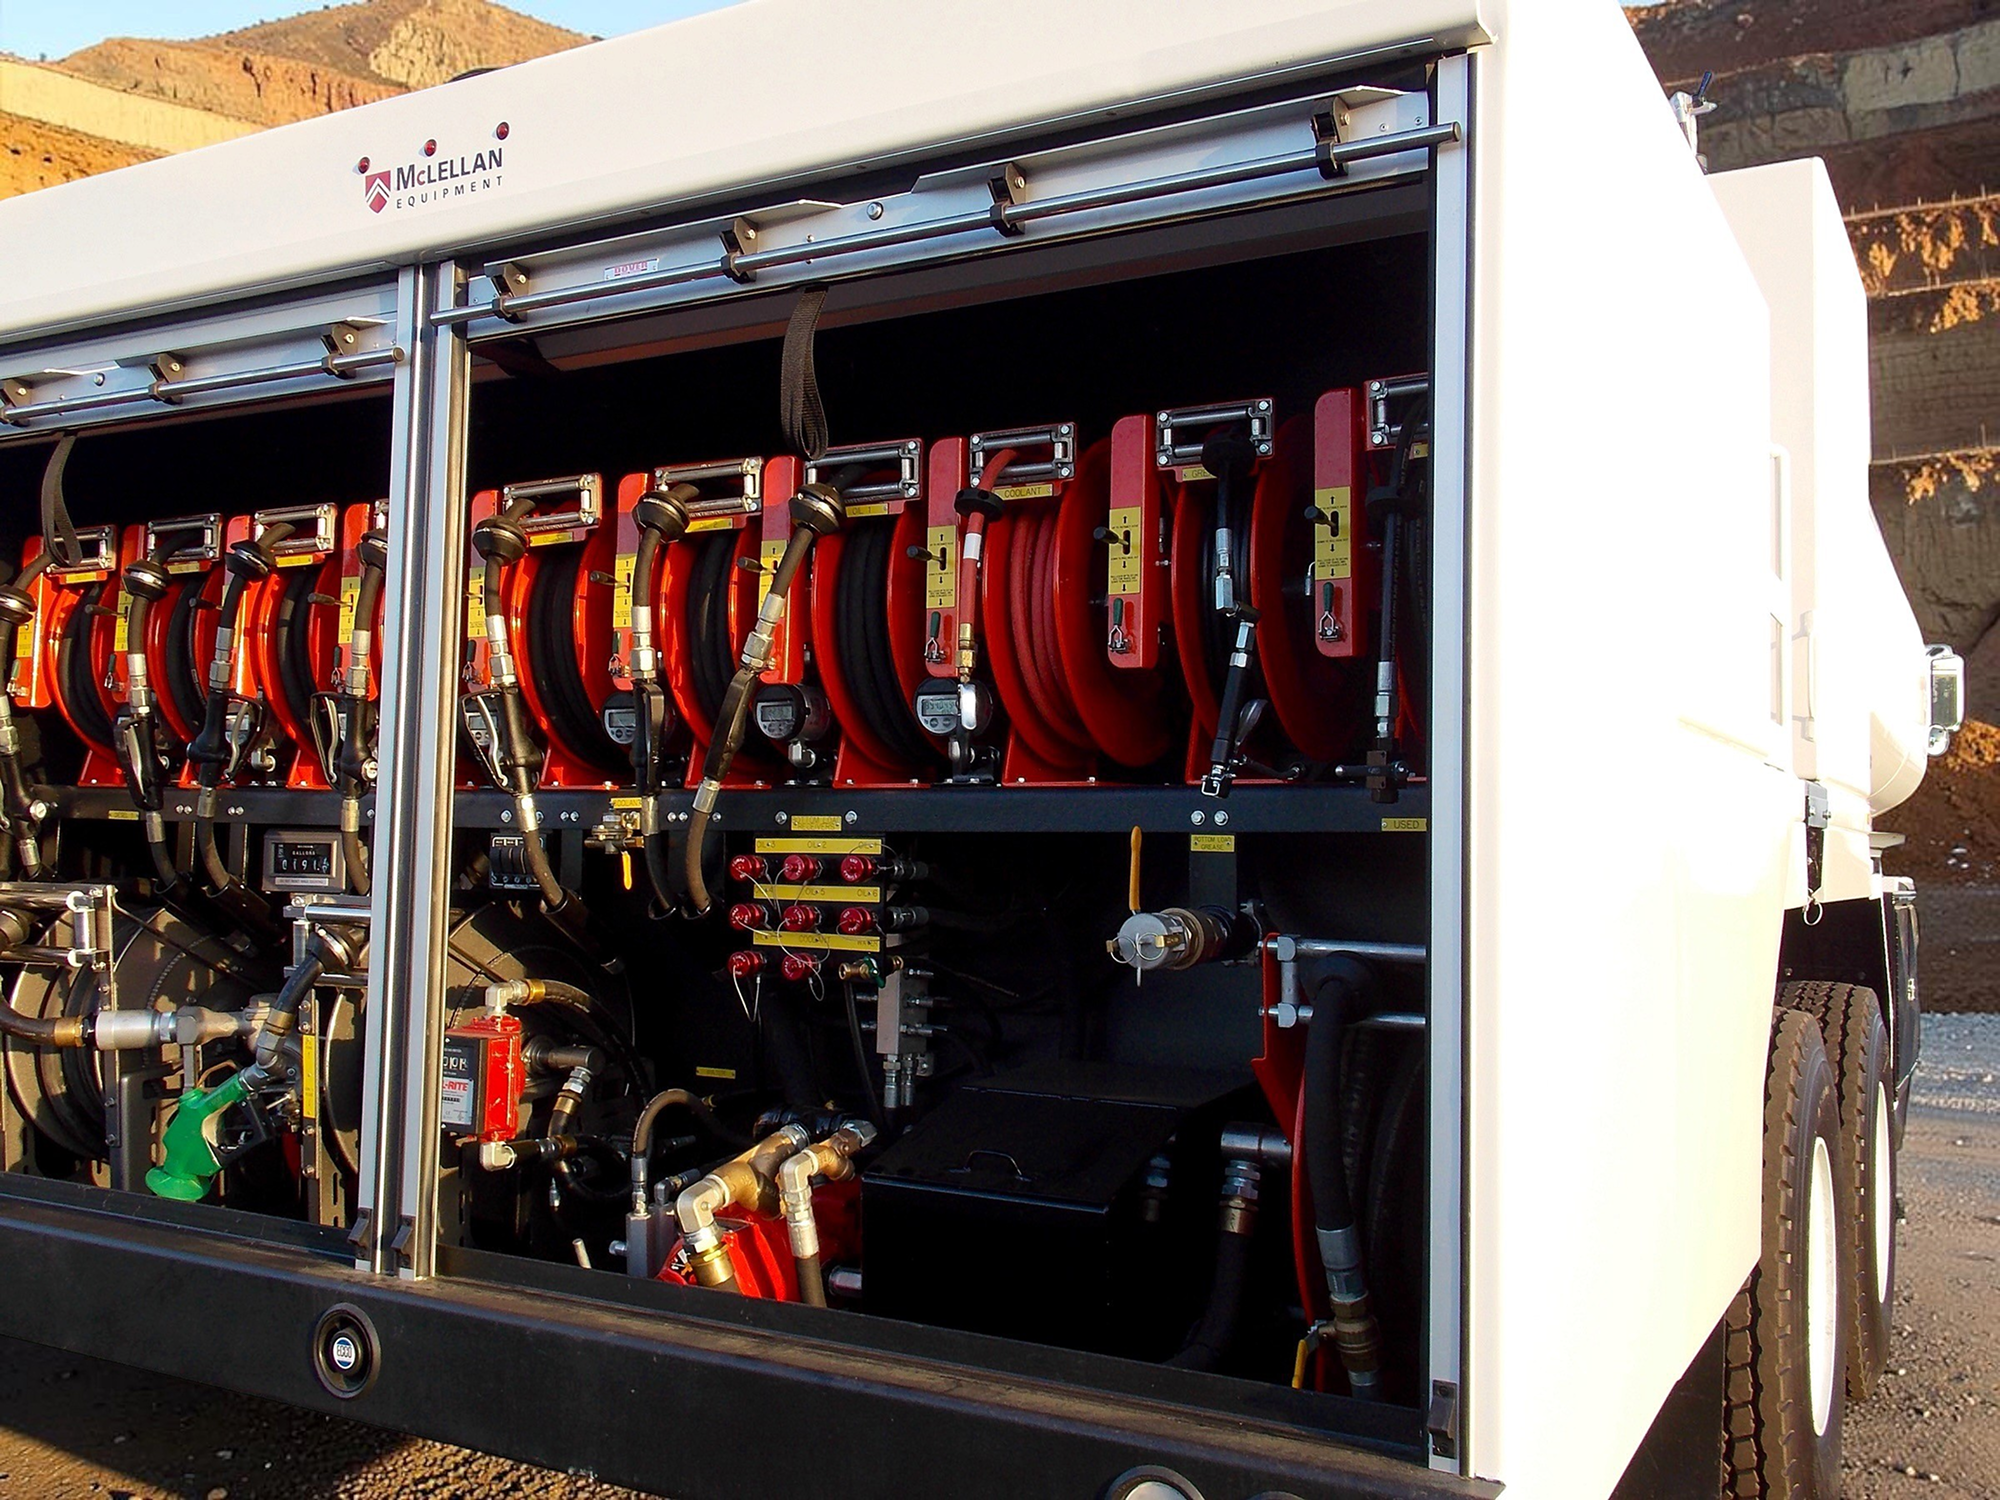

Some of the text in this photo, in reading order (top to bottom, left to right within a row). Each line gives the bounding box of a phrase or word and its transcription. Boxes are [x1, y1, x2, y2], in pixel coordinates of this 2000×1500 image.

[396, 148, 503, 191] McLELLAN
[396, 176, 503, 209] EQUIPMENT
[1192, 469, 1210, 479] GRE
[1004, 486, 1042, 498] COOLANT
[1393, 820, 1420, 830] USED
